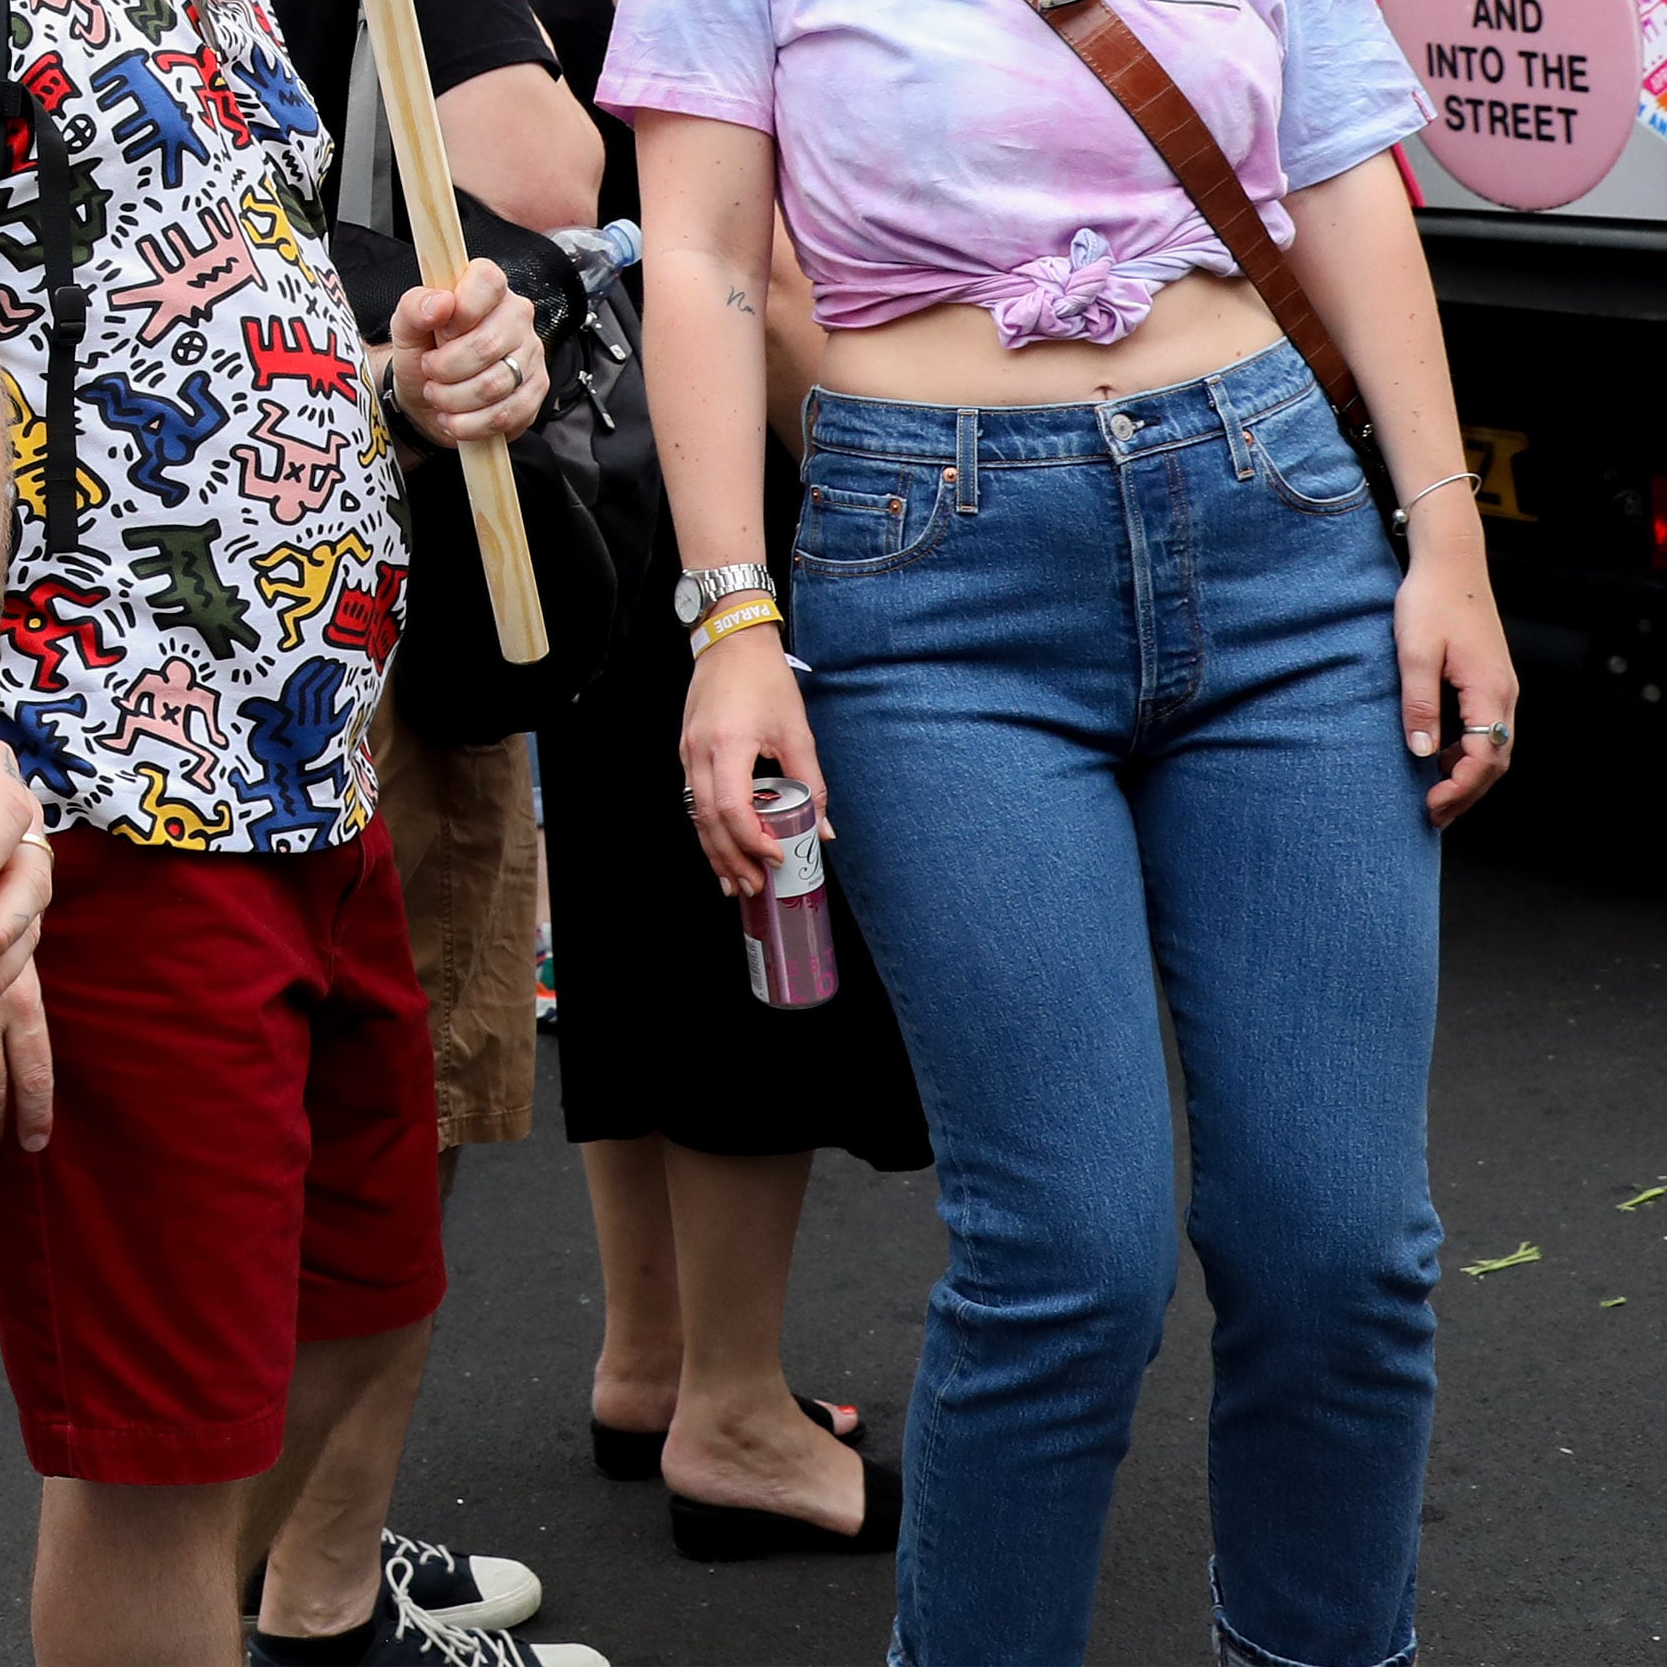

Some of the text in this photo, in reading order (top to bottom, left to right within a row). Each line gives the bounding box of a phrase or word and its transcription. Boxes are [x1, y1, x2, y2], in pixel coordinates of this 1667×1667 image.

[1426, 42, 1591, 95] INTO THE
[1443, 93, 1579, 146] STREET
